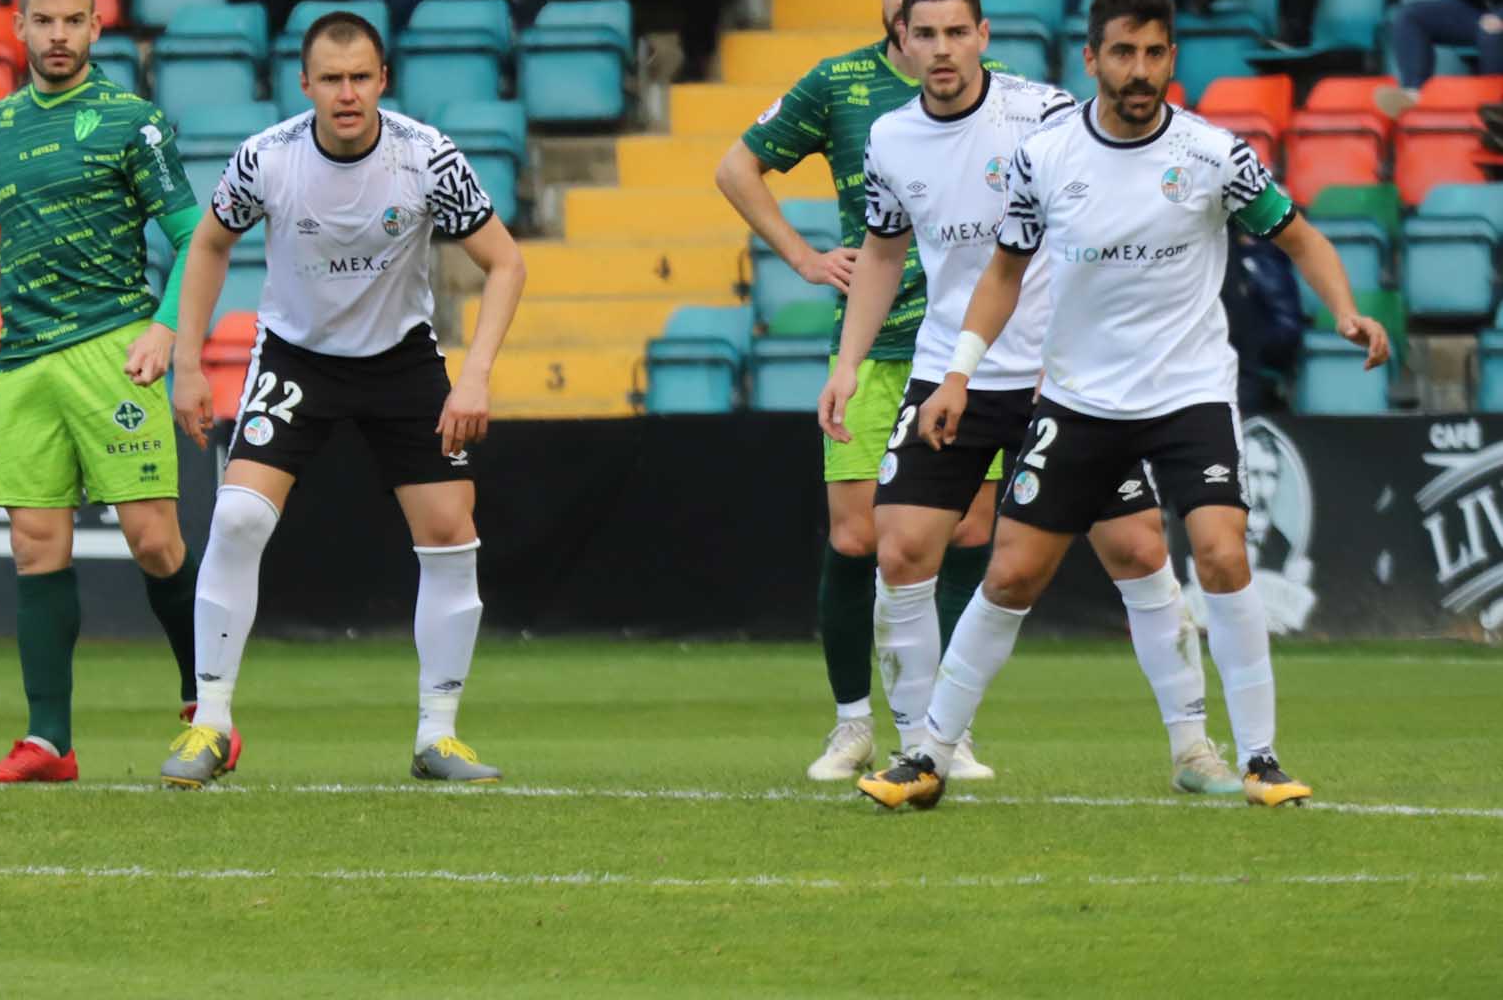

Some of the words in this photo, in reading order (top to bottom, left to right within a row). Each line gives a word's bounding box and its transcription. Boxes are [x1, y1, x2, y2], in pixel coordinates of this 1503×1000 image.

[653, 255, 671, 282] 4
[546, 363, 566, 391] 3
[245, 370, 304, 425] 22
[887, 404, 918, 450] 3
[1023, 417, 1059, 471] 2
[106, 440, 162, 454] BEHER
